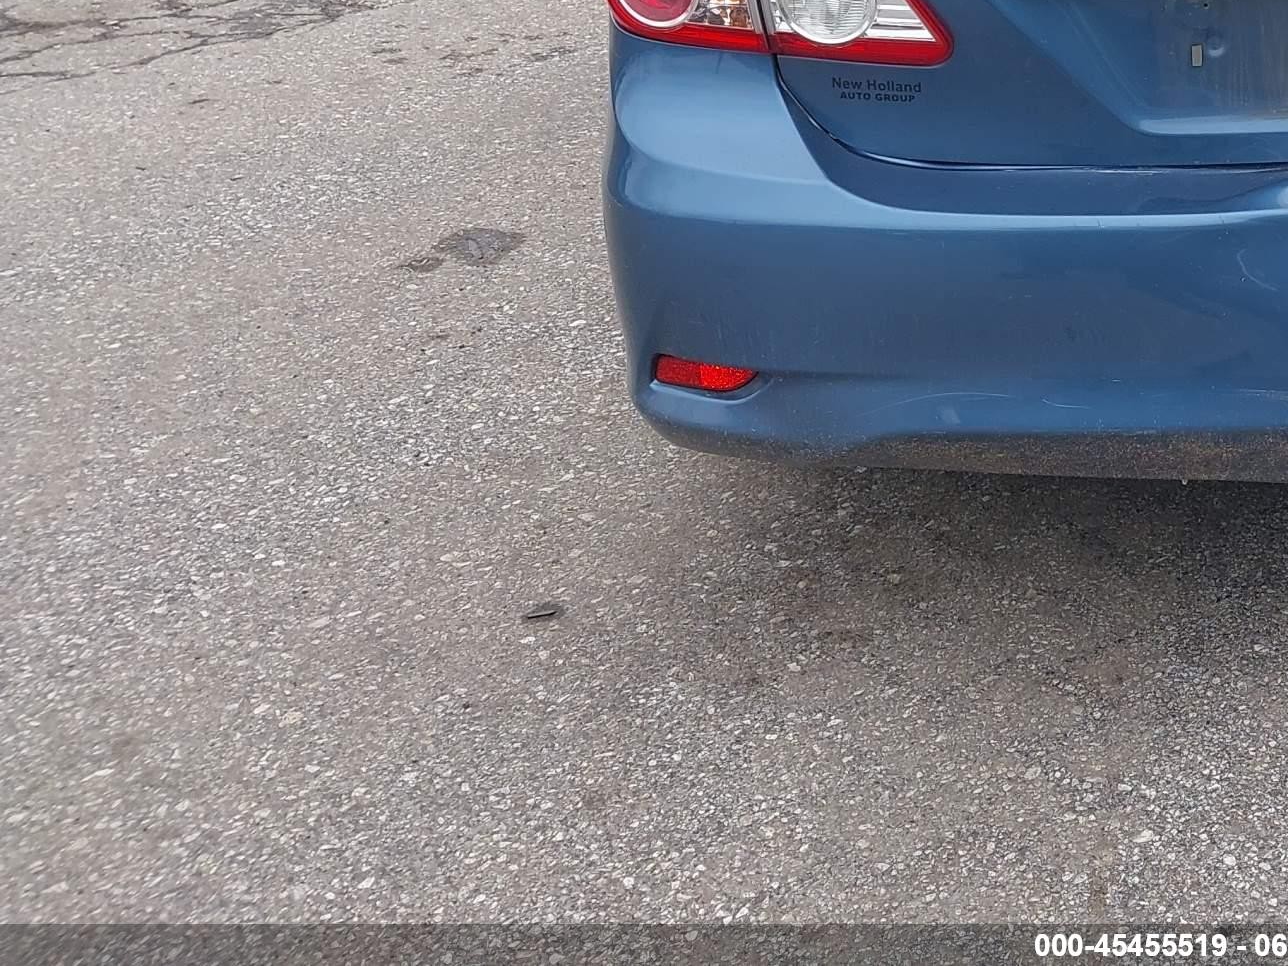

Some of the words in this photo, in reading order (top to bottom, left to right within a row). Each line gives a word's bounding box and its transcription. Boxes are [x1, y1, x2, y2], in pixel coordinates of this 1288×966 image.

[832, 77, 862, 90] New
[867, 79, 922, 93] Holland
[840, 91, 871, 101] AUTO
[875, 93, 915, 103] GROUP
